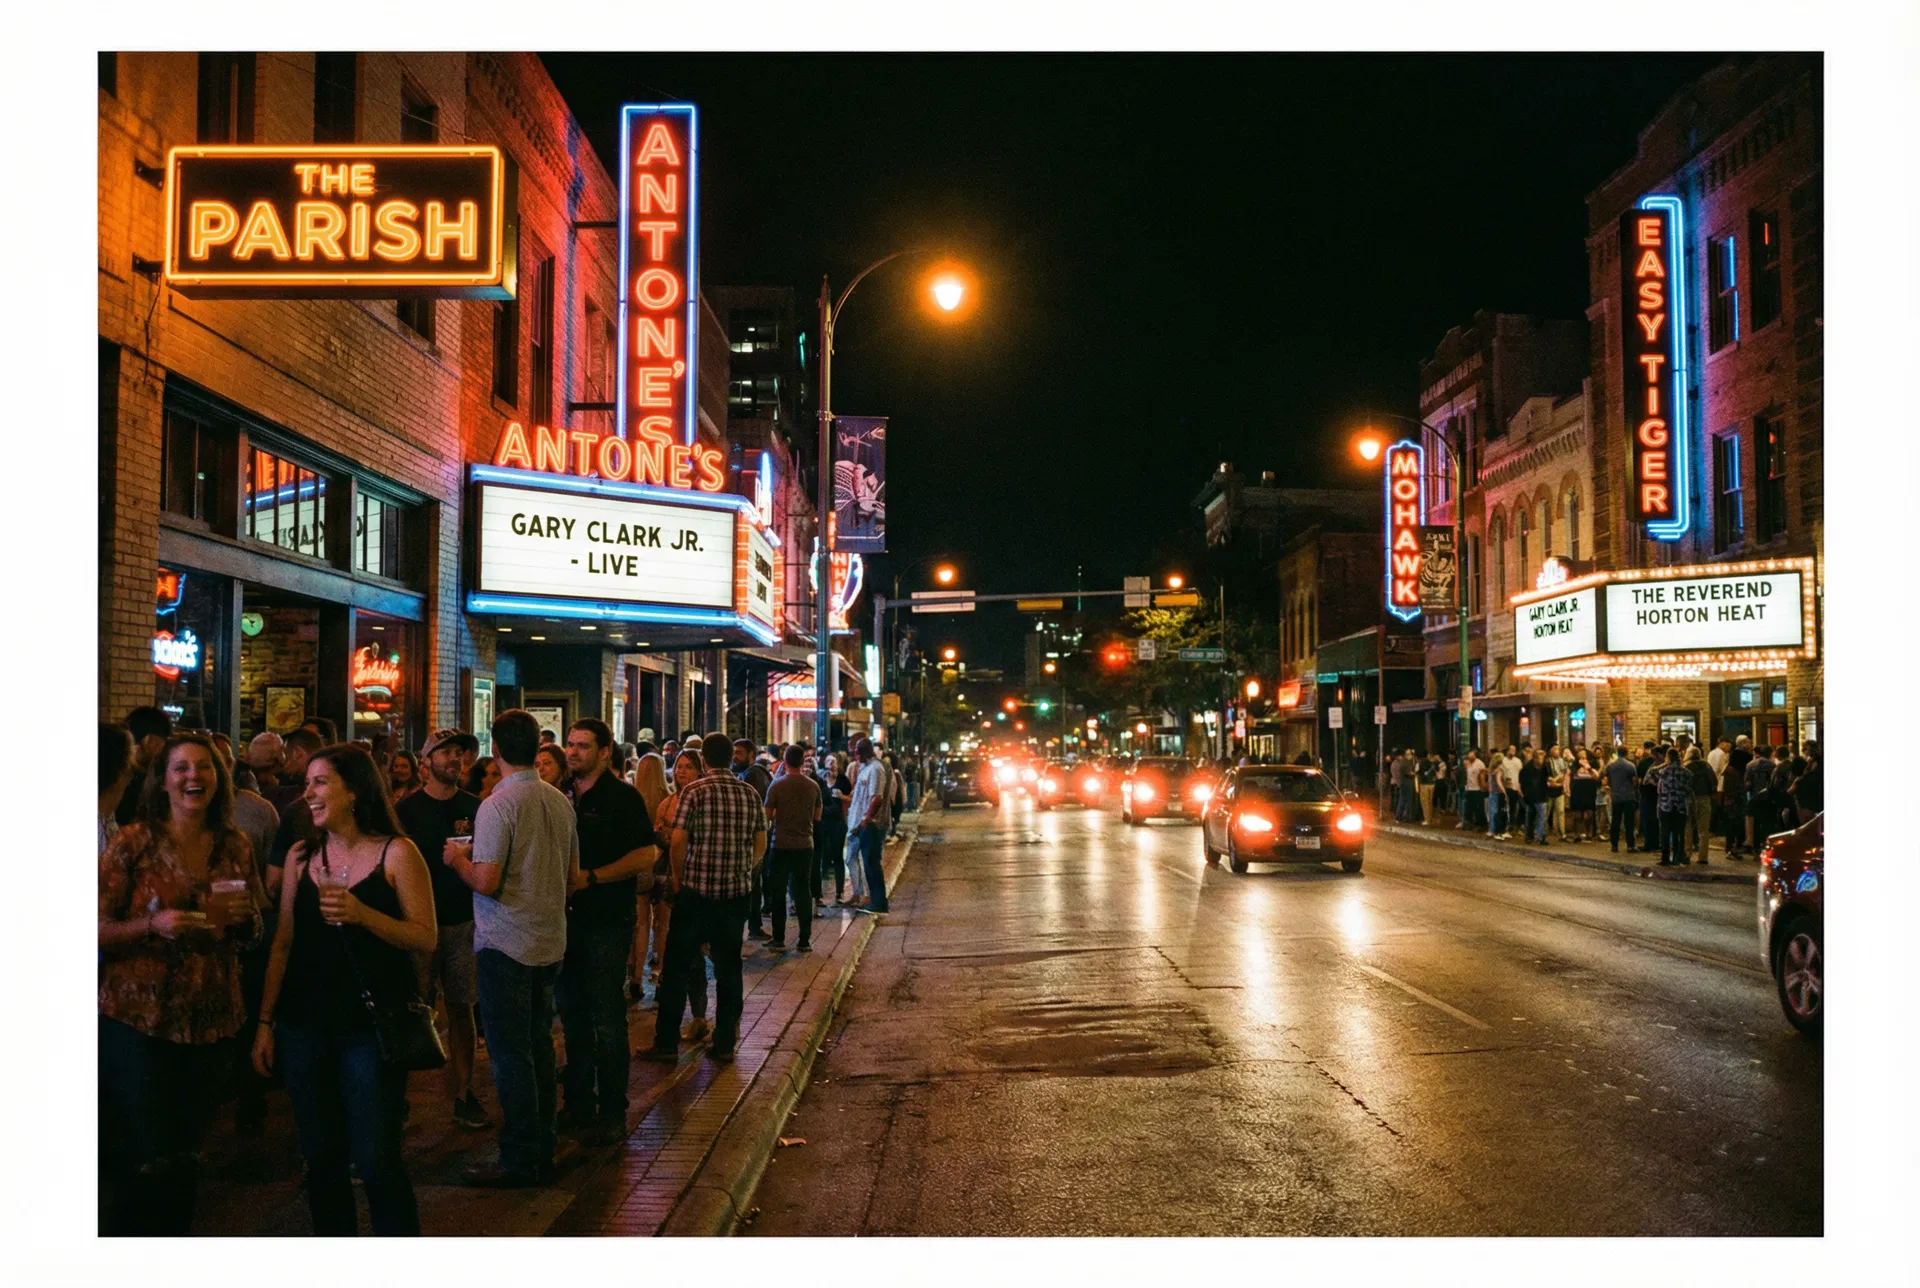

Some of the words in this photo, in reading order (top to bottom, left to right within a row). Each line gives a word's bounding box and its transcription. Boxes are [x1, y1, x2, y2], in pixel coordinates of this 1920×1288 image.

[294, 163, 376, 196] THE
[188, 200, 479, 262] PARISH
[637, 123, 686, 446] ANTONE'S
[1637, 216, 1666, 342] EASY
[497, 420, 726, 493] ANTONE'S
[1640, 353, 1669, 514] TIGER
[511, 513, 576, 540] GARY
[587, 521, 662, 548] CLARK
[671, 529, 704, 552] JR.
[1391, 452, 1421, 606] MOHAWK
[588, 552, 638, 577] LIVE
[1632, 588, 1665, 604] THE
[1674, 581, 1773, 602] REVEREND
[1636, 606, 1708, 625] HORTON
[1718, 604, 1766, 621] HEAT
